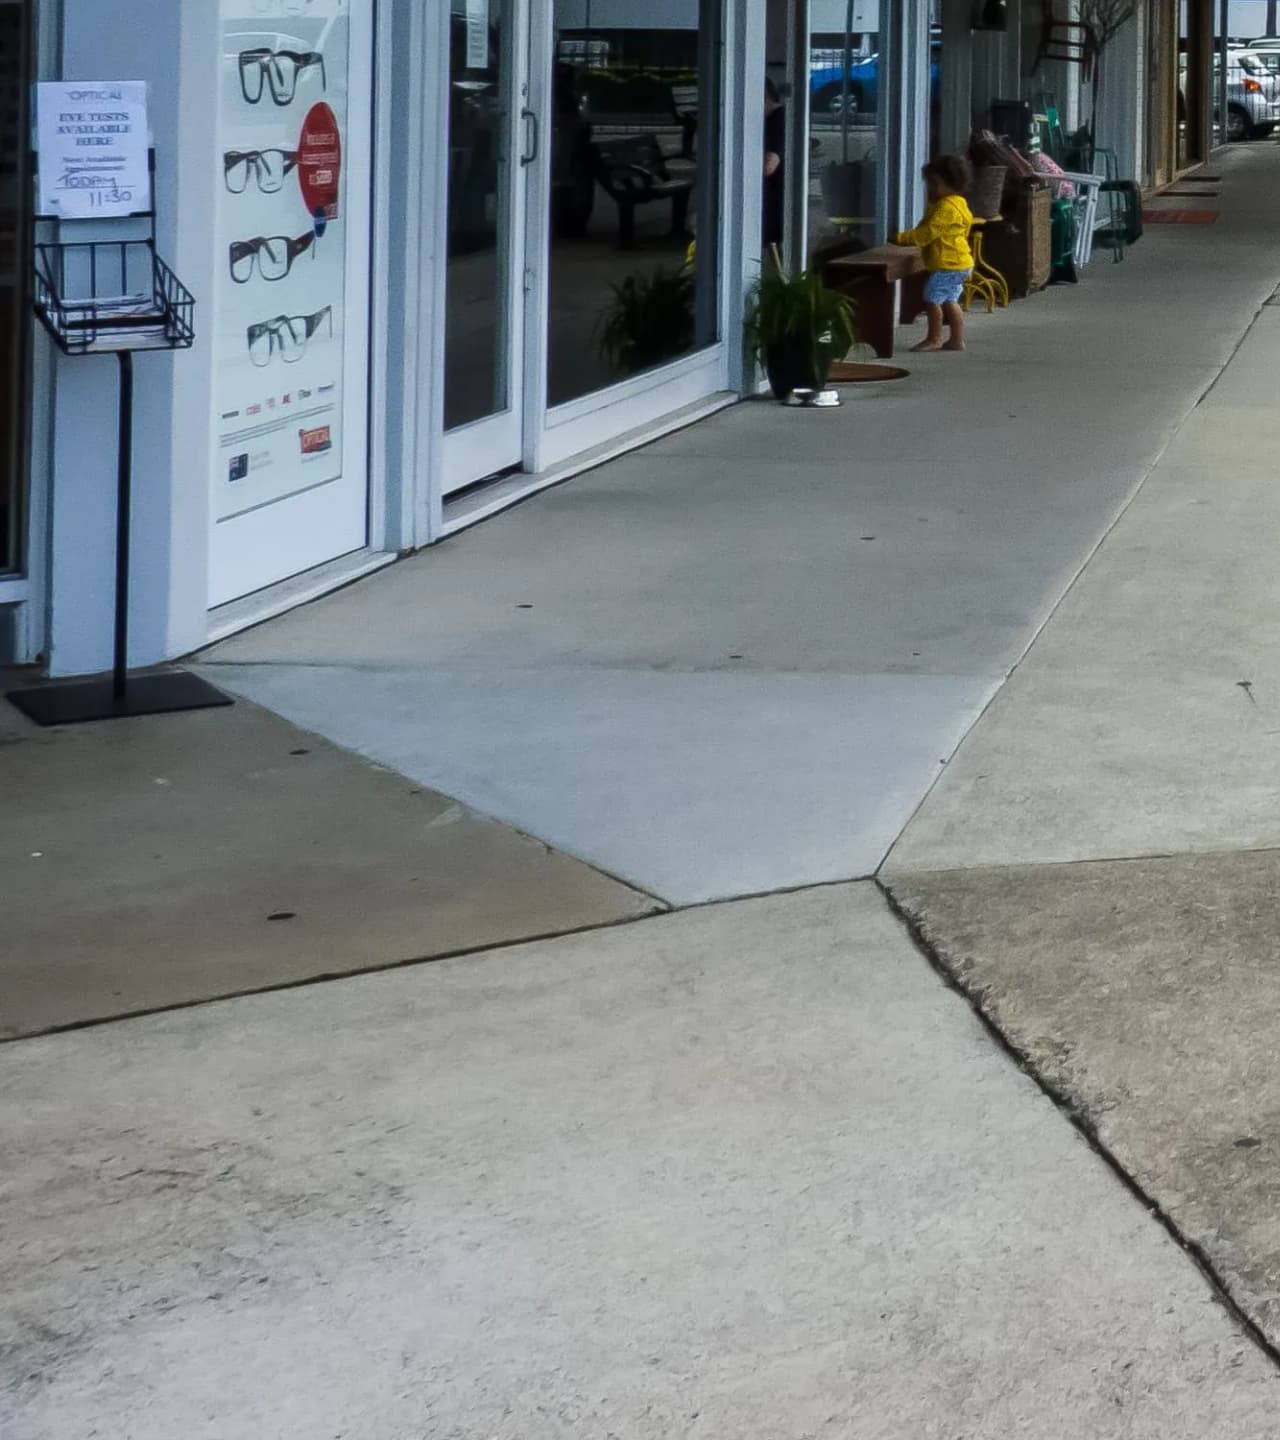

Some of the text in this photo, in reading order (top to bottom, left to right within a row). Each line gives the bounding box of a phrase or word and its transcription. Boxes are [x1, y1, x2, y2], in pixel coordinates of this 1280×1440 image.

[87, 111, 130, 121] TESTS
[57, 125, 130, 134] AVAILABLE
[75, 137, 112, 146] HERE
